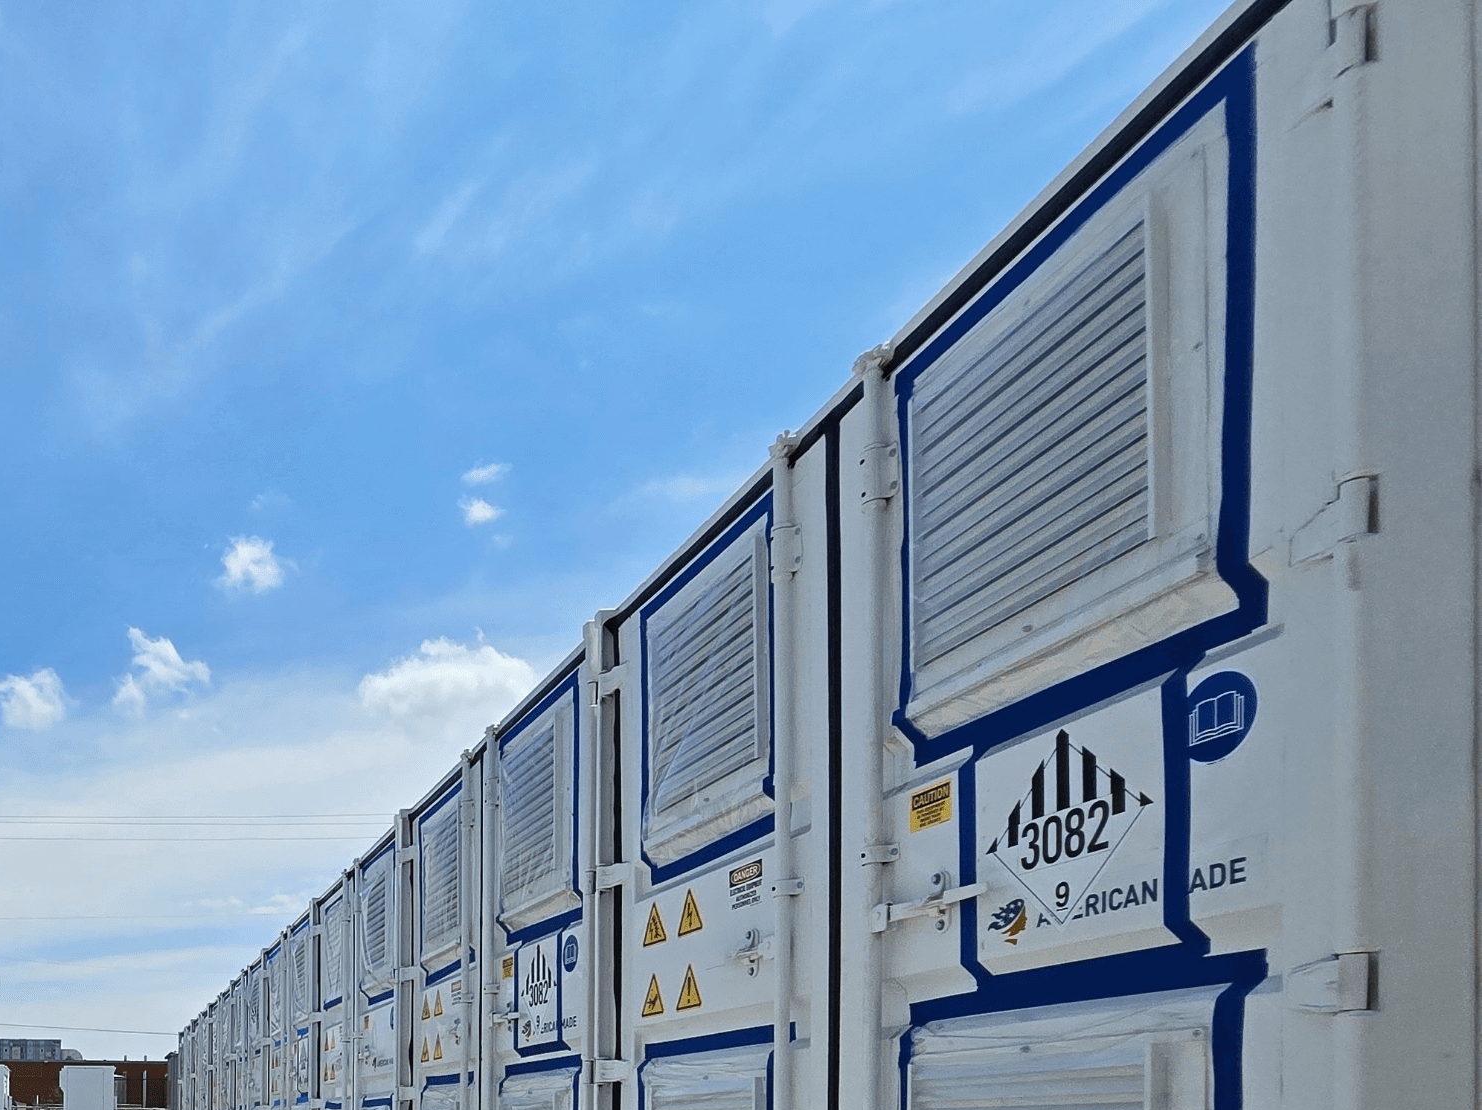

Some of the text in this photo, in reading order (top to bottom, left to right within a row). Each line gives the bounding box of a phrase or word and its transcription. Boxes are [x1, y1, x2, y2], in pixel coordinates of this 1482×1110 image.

[913, 786, 949, 808] CAUTION
[1021, 800, 1110, 871] 3082
[733, 865, 758, 883] DANGER
[1187, 856, 1247, 895] ADE
[1055, 881, 1070, 908] 9
[529, 980, 549, 1008] 3082
